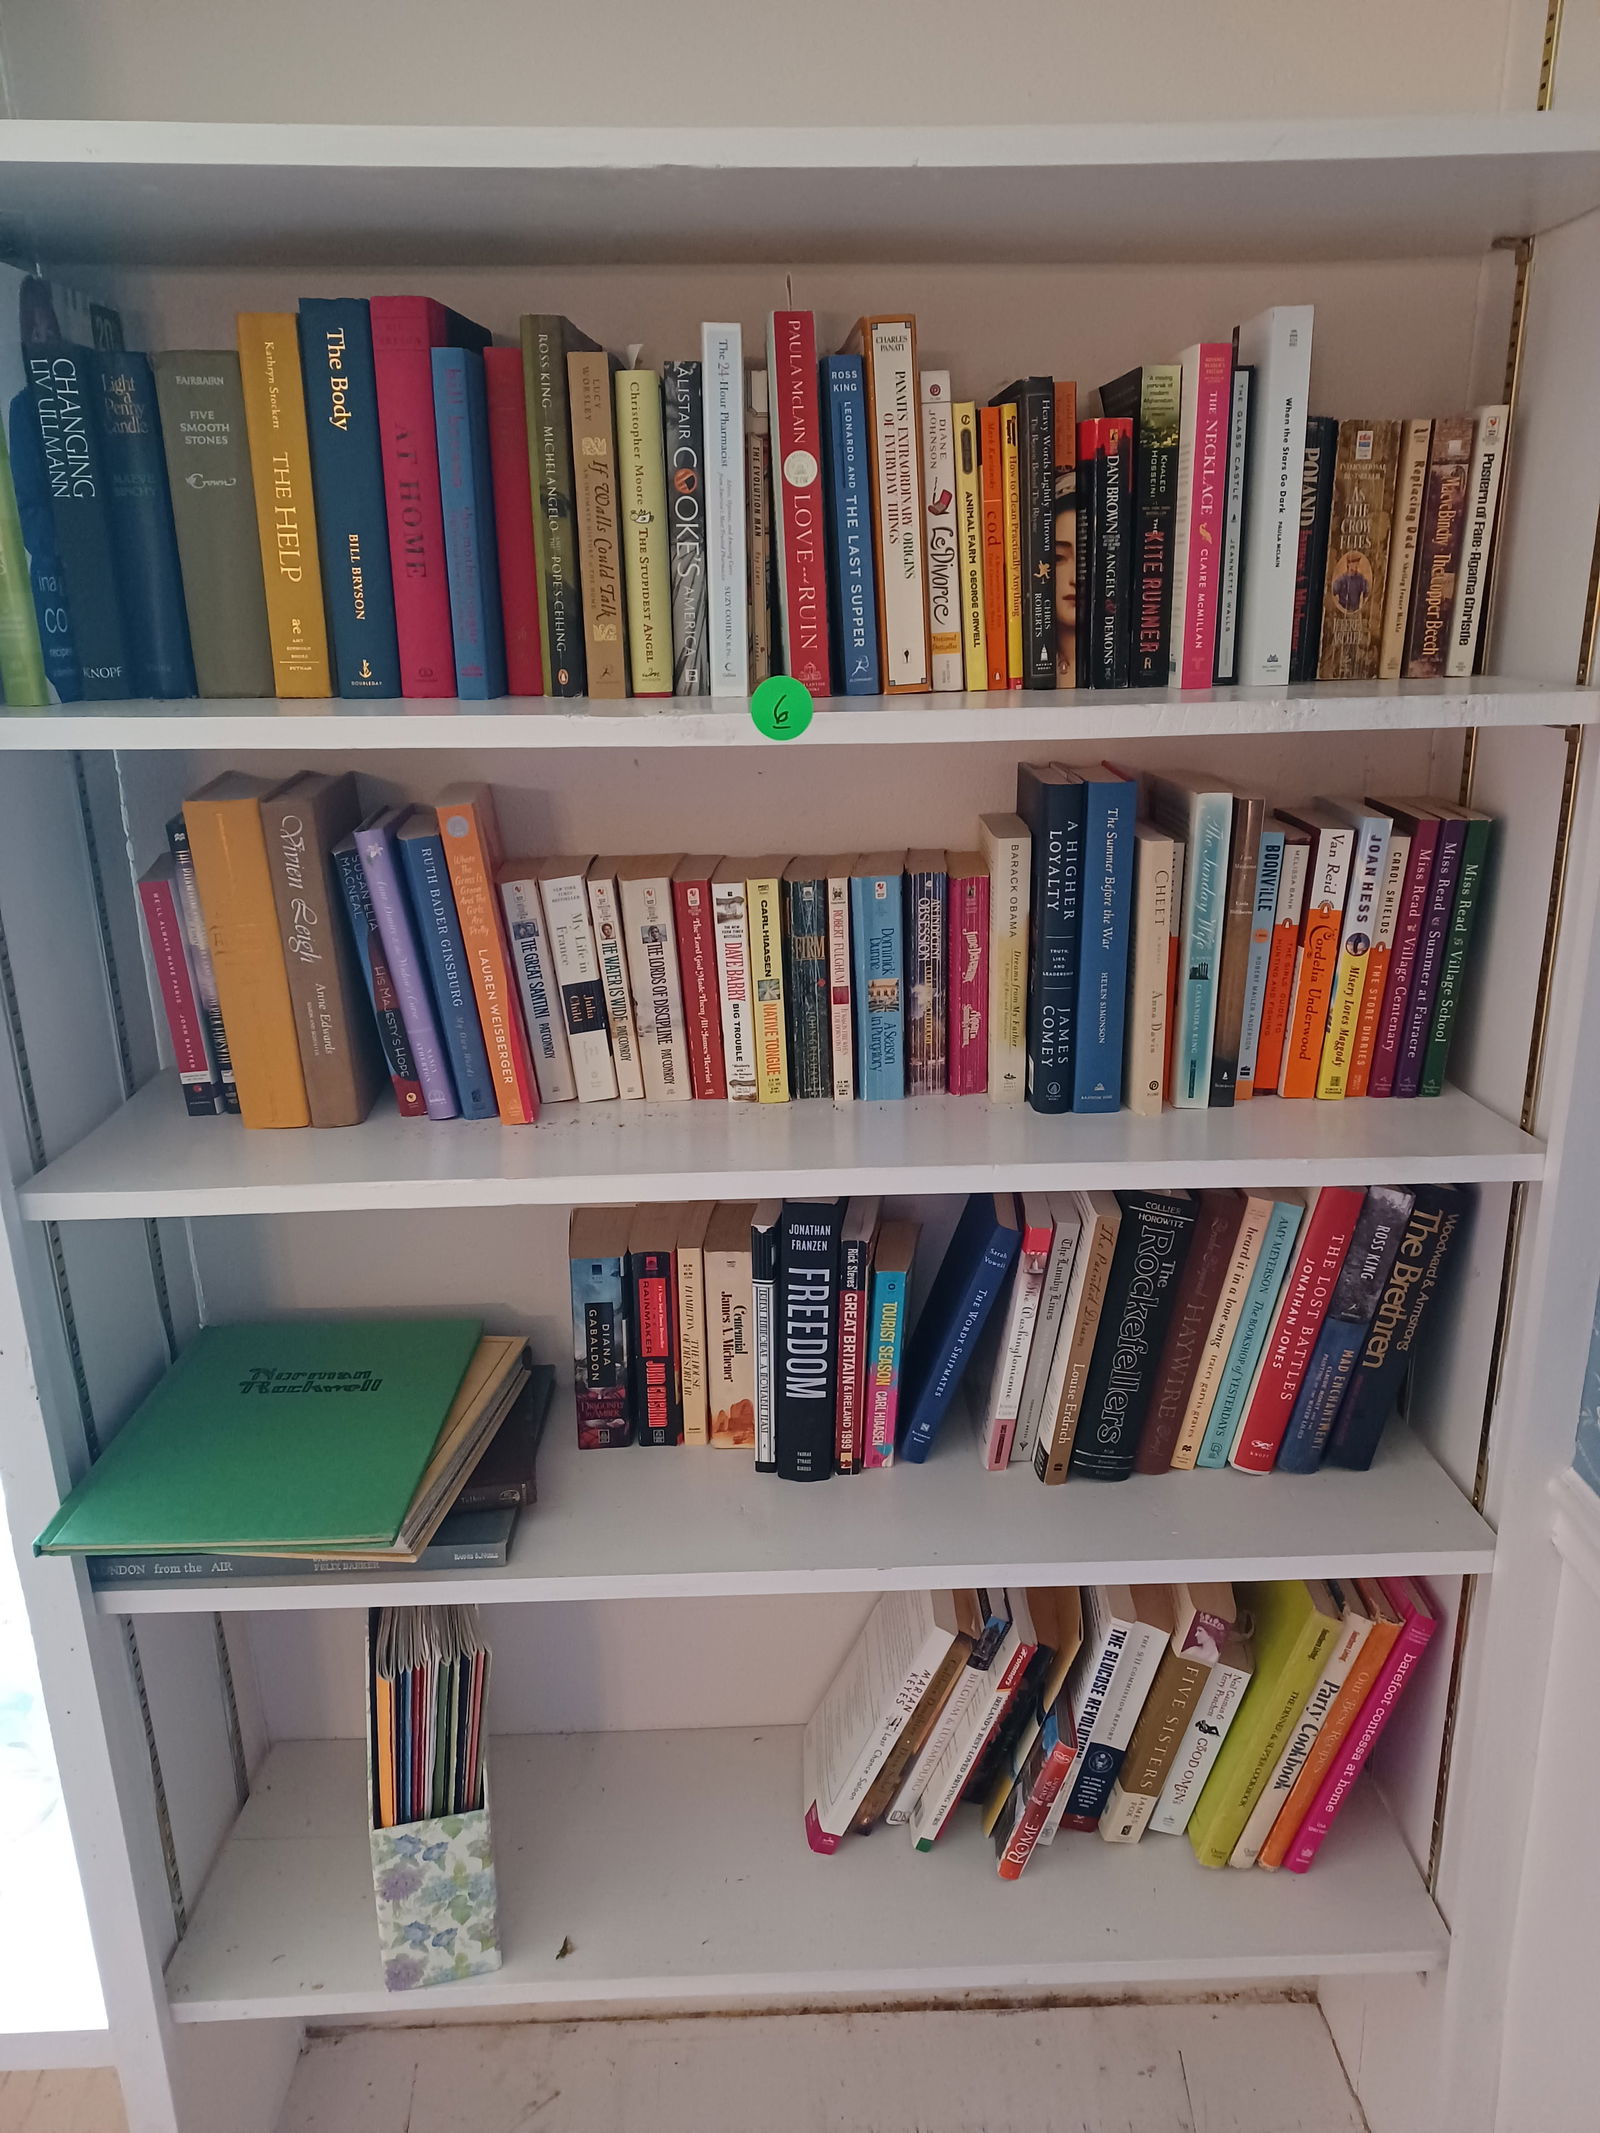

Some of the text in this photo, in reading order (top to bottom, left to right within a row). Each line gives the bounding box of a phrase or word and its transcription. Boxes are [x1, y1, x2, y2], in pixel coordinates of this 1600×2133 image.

[831, 370, 858, 379] ROSS
[876, 335, 908, 344] CHARLES
[880, 343, 904, 352] PANATI
[176, 376, 223, 385] FAIRBAIRN
[191, 411, 214, 419] FIVE
[326, 327, 351, 432] The Body
[582, 365, 591, 421] WORSLEY
[592, 378, 600, 408] LUCY
[833, 384, 857, 392] KING
[1208, 391, 1217, 414] THE
[30, 359, 69, 497] LIV ULLMANN
[52, 358, 95, 497] CHANGING
[180, 423, 229, 432] SMOOTH
[185, 436, 228, 445] STONES
[628, 381, 645, 505] Christopher Moore
[752, 446, 761, 536] THE EVOLUTION MAN
[1200, 419, 1217, 515] NECKLACE
[1232, 456, 1240, 500] CASTLE
[272, 451, 302, 583] THE HELP
[844, 401, 864, 646] LEONARDO AND THE LAST SUPPER
[1009, 455, 1020, 616] How to Clean Practically Anything
[349, 533, 365, 620] BILL BRYSON
[793, 494, 817, 649] LOVE RUIN
[965, 490, 981, 648] ANIMAL FARM GEORGE ORWELL
[1226, 538, 1235, 594] JEANNETTE
[774, 694, 788, 724] 6
[1009, 844, 1019, 937] BARACK OBAMA
[1046, 830, 1062, 910] LOYALTY
[1063, 821, 1078, 919] A HIGHER
[1101, 807, 1118, 950] The Summer Before the War
[1287, 849, 1300, 909] MELISSA BANK
[1323, 834, 1344, 894] Van Reid
[1356, 834, 1381, 922] JOAN HESS
[1379, 851, 1402, 933] CAROL SHIELDS
[421, 848, 462, 1006] RUTH BADER GINSBURG
[760, 899, 771, 977] CARL HIAASEN
[1381, 849, 1432, 1051] Miss Read Village Centenary
[1407, 842, 1457, 1057] Miss Read Summer at Fairacre
[1434, 864, 1478, 1041] Miss Read Village School
[723, 941, 746, 1002] DAVE BARRY
[478, 949, 513, 1083] LAUREN WEISBERGER
[732, 1003, 740, 1018] BIG
[733, 1021, 742, 1061] TROUBLE
[763, 1003, 779, 1075] NATIVE TONGUE
[1040, 1004, 1055, 1067] COMEY
[1056, 1007, 1070, 1064] JAMES
[1097, 972, 1108, 1043] HELEN SIMONSON
[789, 1224, 831, 1236] JONATHAN
[792, 1240, 827, 1251] FRANZEN
[990, 1248, 1007, 1259] Sarah
[1138, 1213, 1184, 1228] HOROWITZ
[1259, 1216, 1288, 1292] AMY MEYERSON
[1360, 1224, 1390, 1279] ROSS KING
[984, 1257, 1006, 1269] Vowell
[1158, 1261, 1176, 1288] The
[1362, 1209, 1445, 1367] The Brethren
[1396, 1213, 1459, 1351] Woodward & Armstrong
[588, 1309, 599, 1380] GABALDON
[601, 1323, 610, 1366] DIANA
[785, 1267, 829, 1397] FREEDOM
[843, 1293, 856, 1332] GREAT
[875, 1301, 897, 1385] TOURIST SEASON
[1097, 1225, 1175, 1444] Rockefellers
[1272, 1257, 1314, 1368] JONATHAN JONES
[1280, 1234, 1344, 1399] THE LOST BATTLES
[239, 1377, 383, 1394] Rockwell
[249, 1368, 372, 1382] Norman
[842, 1335, 855, 1384] BRITAIN
[842, 1392, 852, 1427] IRELAND
[1058, 1363, 1085, 1443] Louise Erdrich
[841, 1430, 851, 1449] 1999
[895, 1672, 918, 1705] KEYES
[902, 1669, 930, 1712] MARIAN
[1106, 1634, 1149, 1740] THE 9/11 COMMISSION REPORT
[1140, 1666, 1199, 1787] FIVE SISTERS
[1273, 1679, 1340, 1789] Party Cookbook
[1325, 1652, 1416, 1812] barefoot contessa at home
[848, 1732, 891, 1800] Last Chance Saloon
